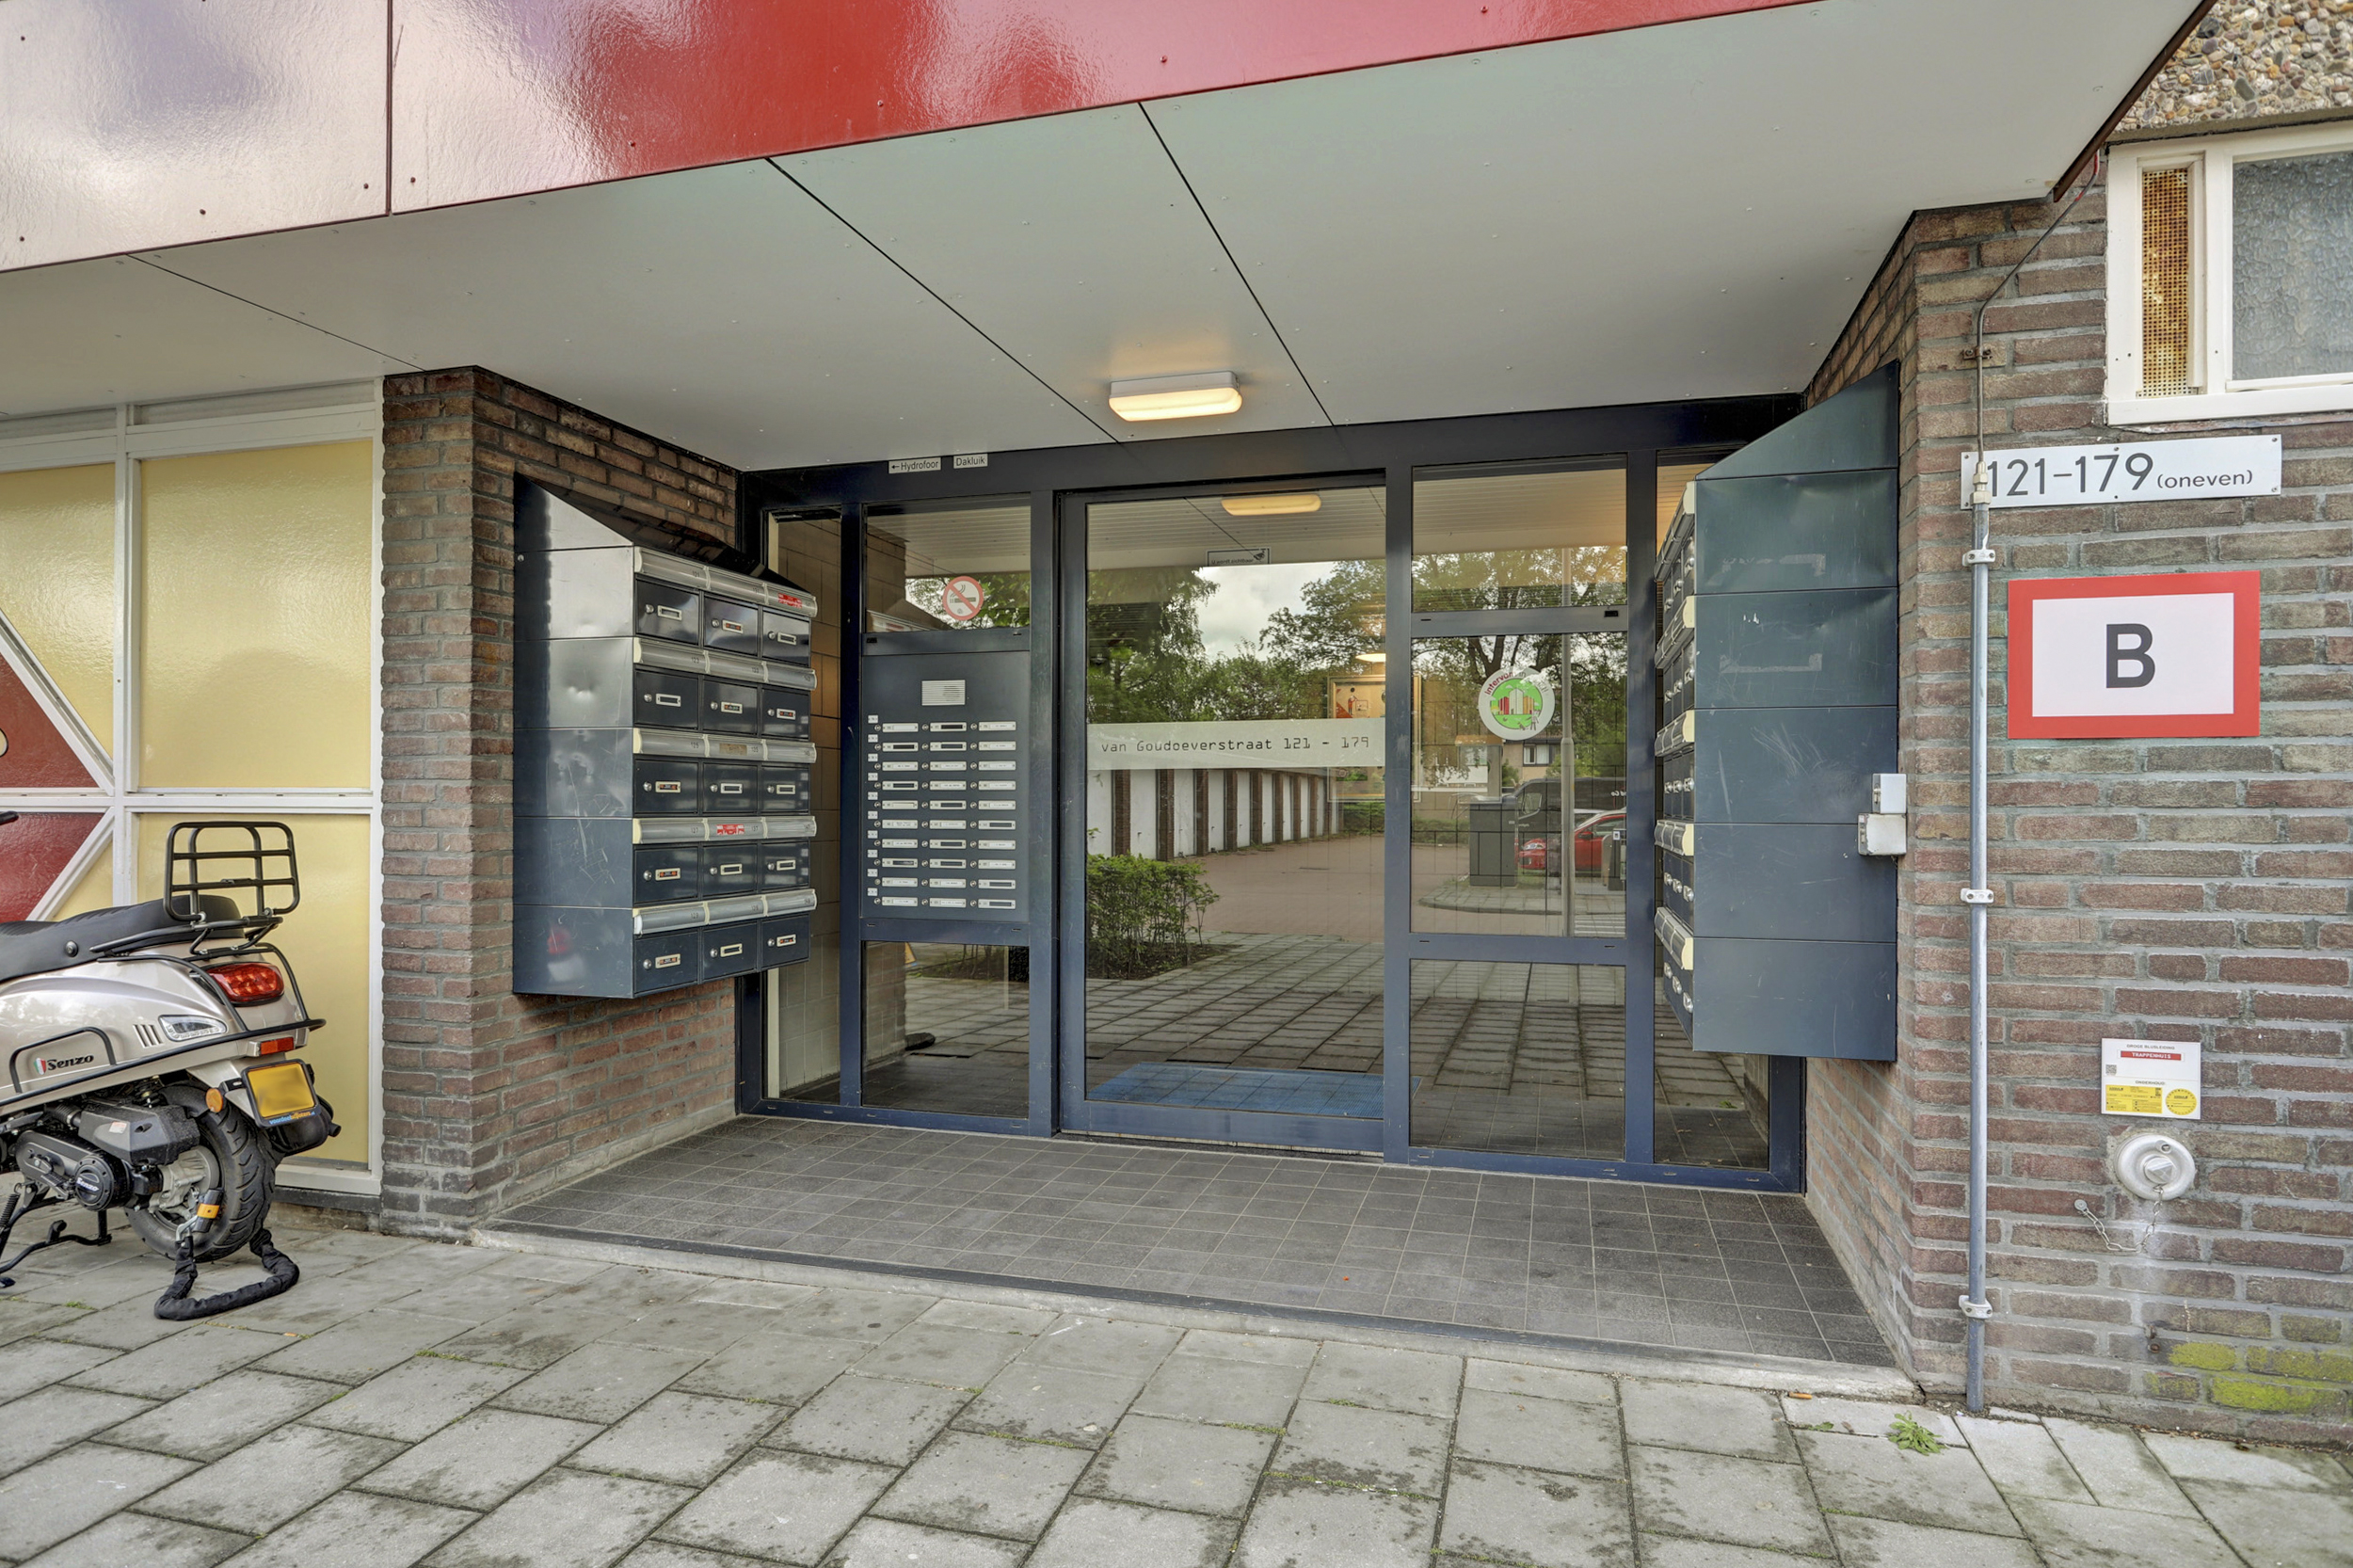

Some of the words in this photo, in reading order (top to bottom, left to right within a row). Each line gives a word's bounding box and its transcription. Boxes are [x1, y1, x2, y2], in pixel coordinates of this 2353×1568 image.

[900, 459, 938, 472] Hydrofoor
[955, 456, 985, 467] Dakluik
[1987, 453, 2153, 497] 121-179
[2157, 469, 2253, 489] (oneven)
[2106, 623, 2155, 689] B
[1101, 742, 1127, 752] van
[1136, 739, 1273, 752] Goudoeverstraat
[1284, 737, 1311, 749] 121
[1341, 736, 1369, 748] 179
[47, 1054, 94, 1071] Senzo
[76, 1176, 99, 1192] Senzo
